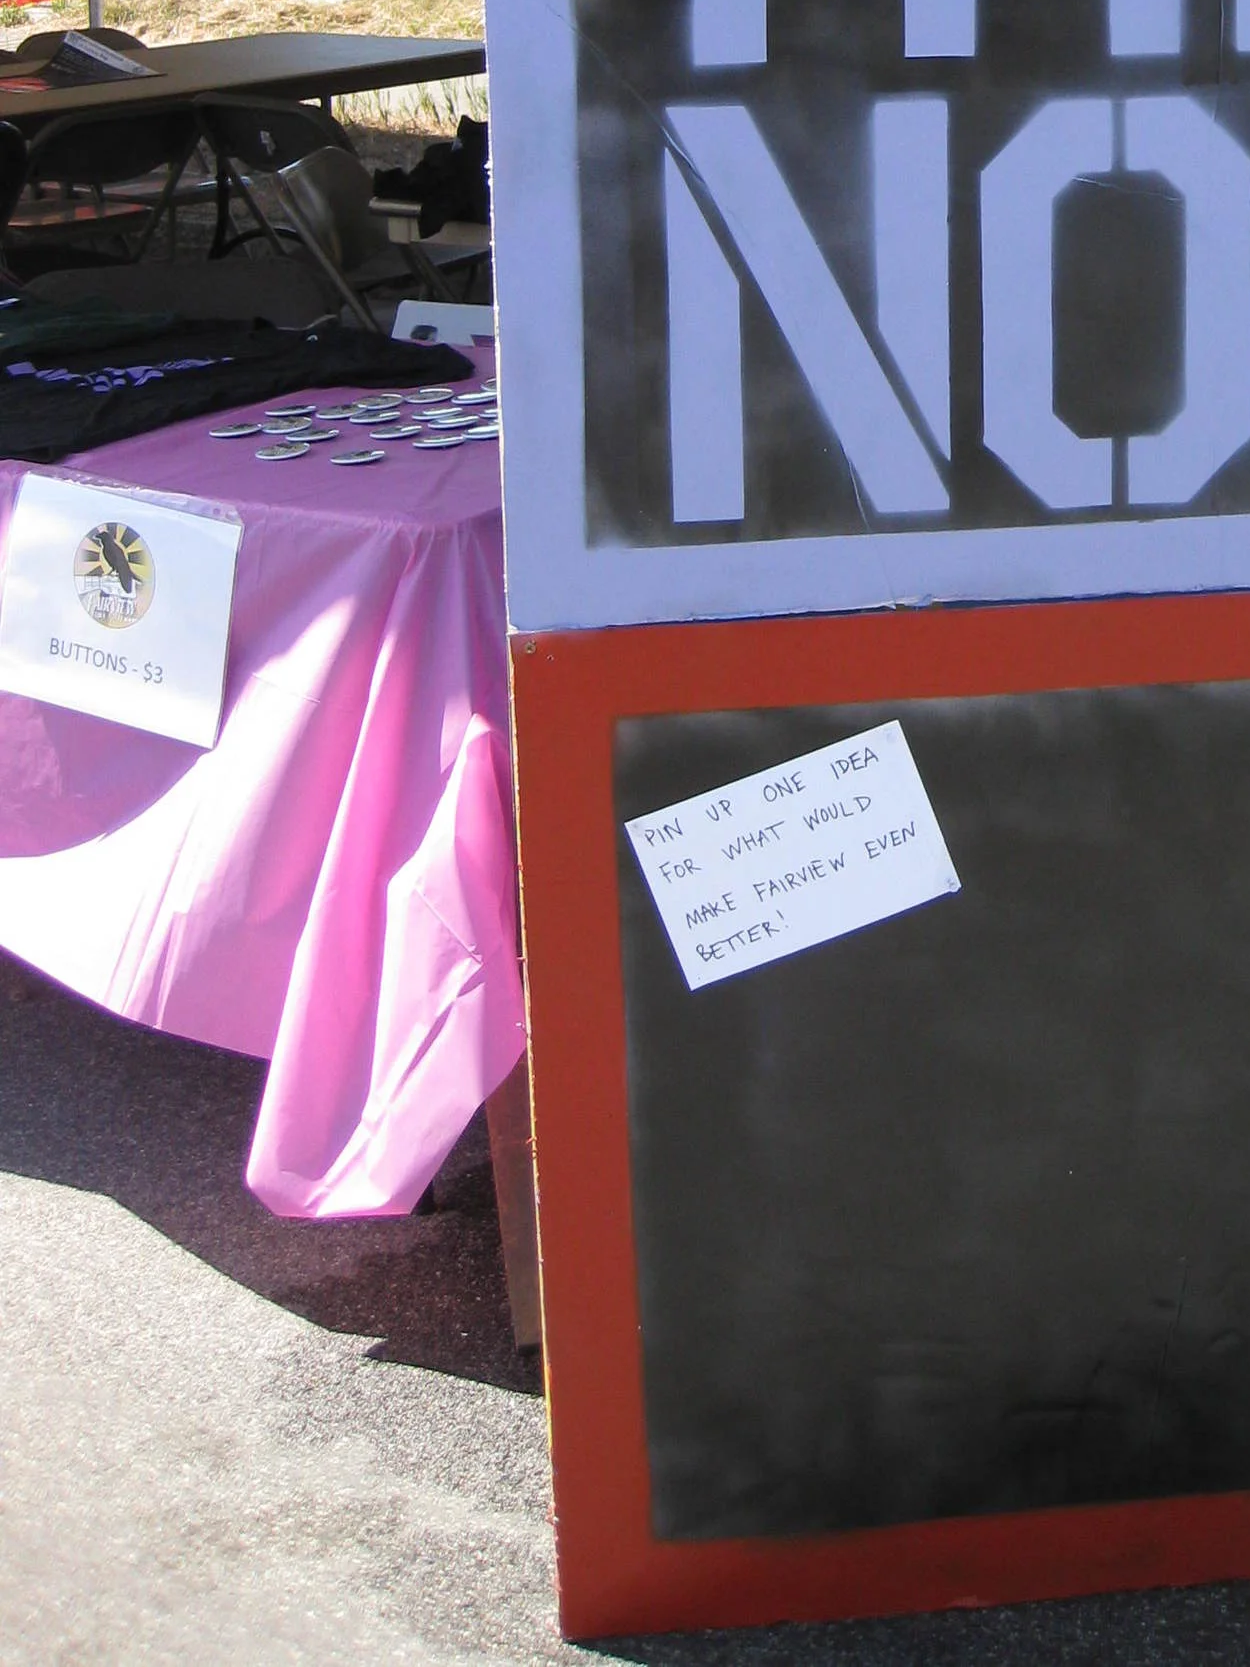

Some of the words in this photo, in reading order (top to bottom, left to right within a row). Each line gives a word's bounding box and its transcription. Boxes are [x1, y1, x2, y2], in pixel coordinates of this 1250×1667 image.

[50, 637, 128, 675] BUTTONS
[143, 661, 164, 685] $3
[644, 818, 684, 847] PIN
[705, 799, 732, 822] UP
[763, 771, 806, 803] ONE
[830, 746, 879, 780] IDEA
[659, 857, 702, 883] FOR
[721, 820, 786, 861] WHAT
[803, 795, 873, 831] WOULD
[685, 892, 737, 929] MAKE
[753, 852, 845, 902] FAIRVIEW
[864, 821, 917, 860] EVEN
[695, 910, 790, 962] BETTER!
